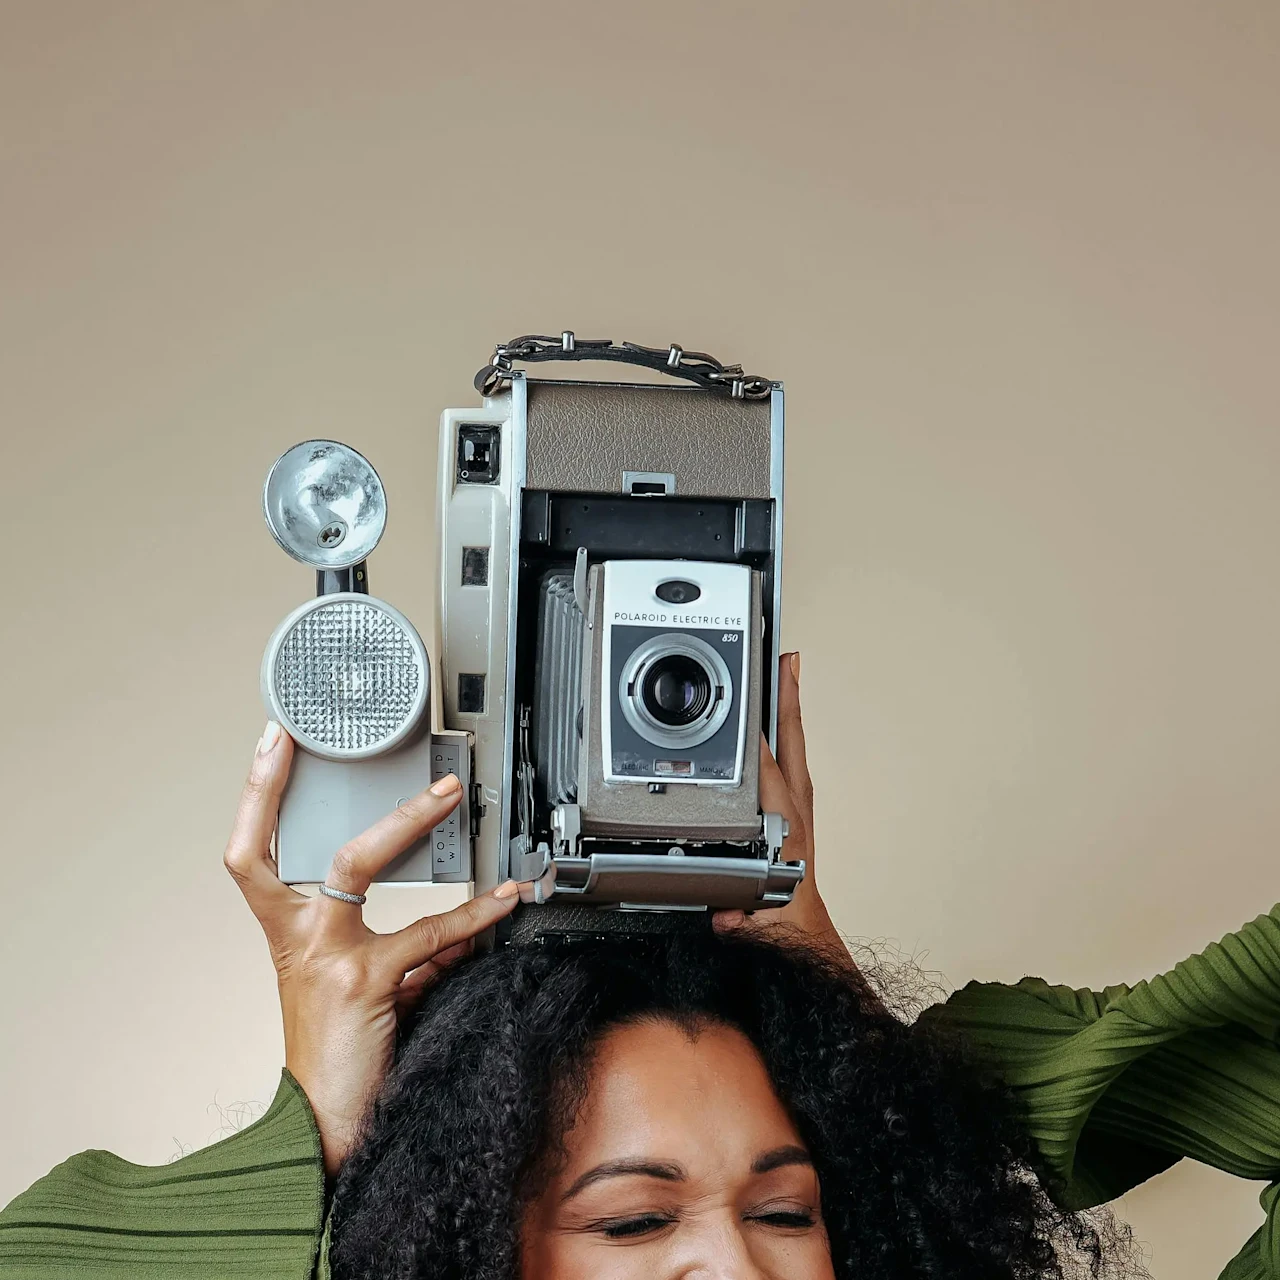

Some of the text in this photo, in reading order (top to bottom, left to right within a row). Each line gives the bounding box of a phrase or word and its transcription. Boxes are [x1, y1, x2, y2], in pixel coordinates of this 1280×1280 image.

[614, 612, 742, 626] POLAROID ELECTRIC EYE
[721, 633, 739, 643] 850
[621, 763, 649, 771] ELECRIC
[435, 754, 445, 863] POLID
[448, 819, 456, 860] WINK
